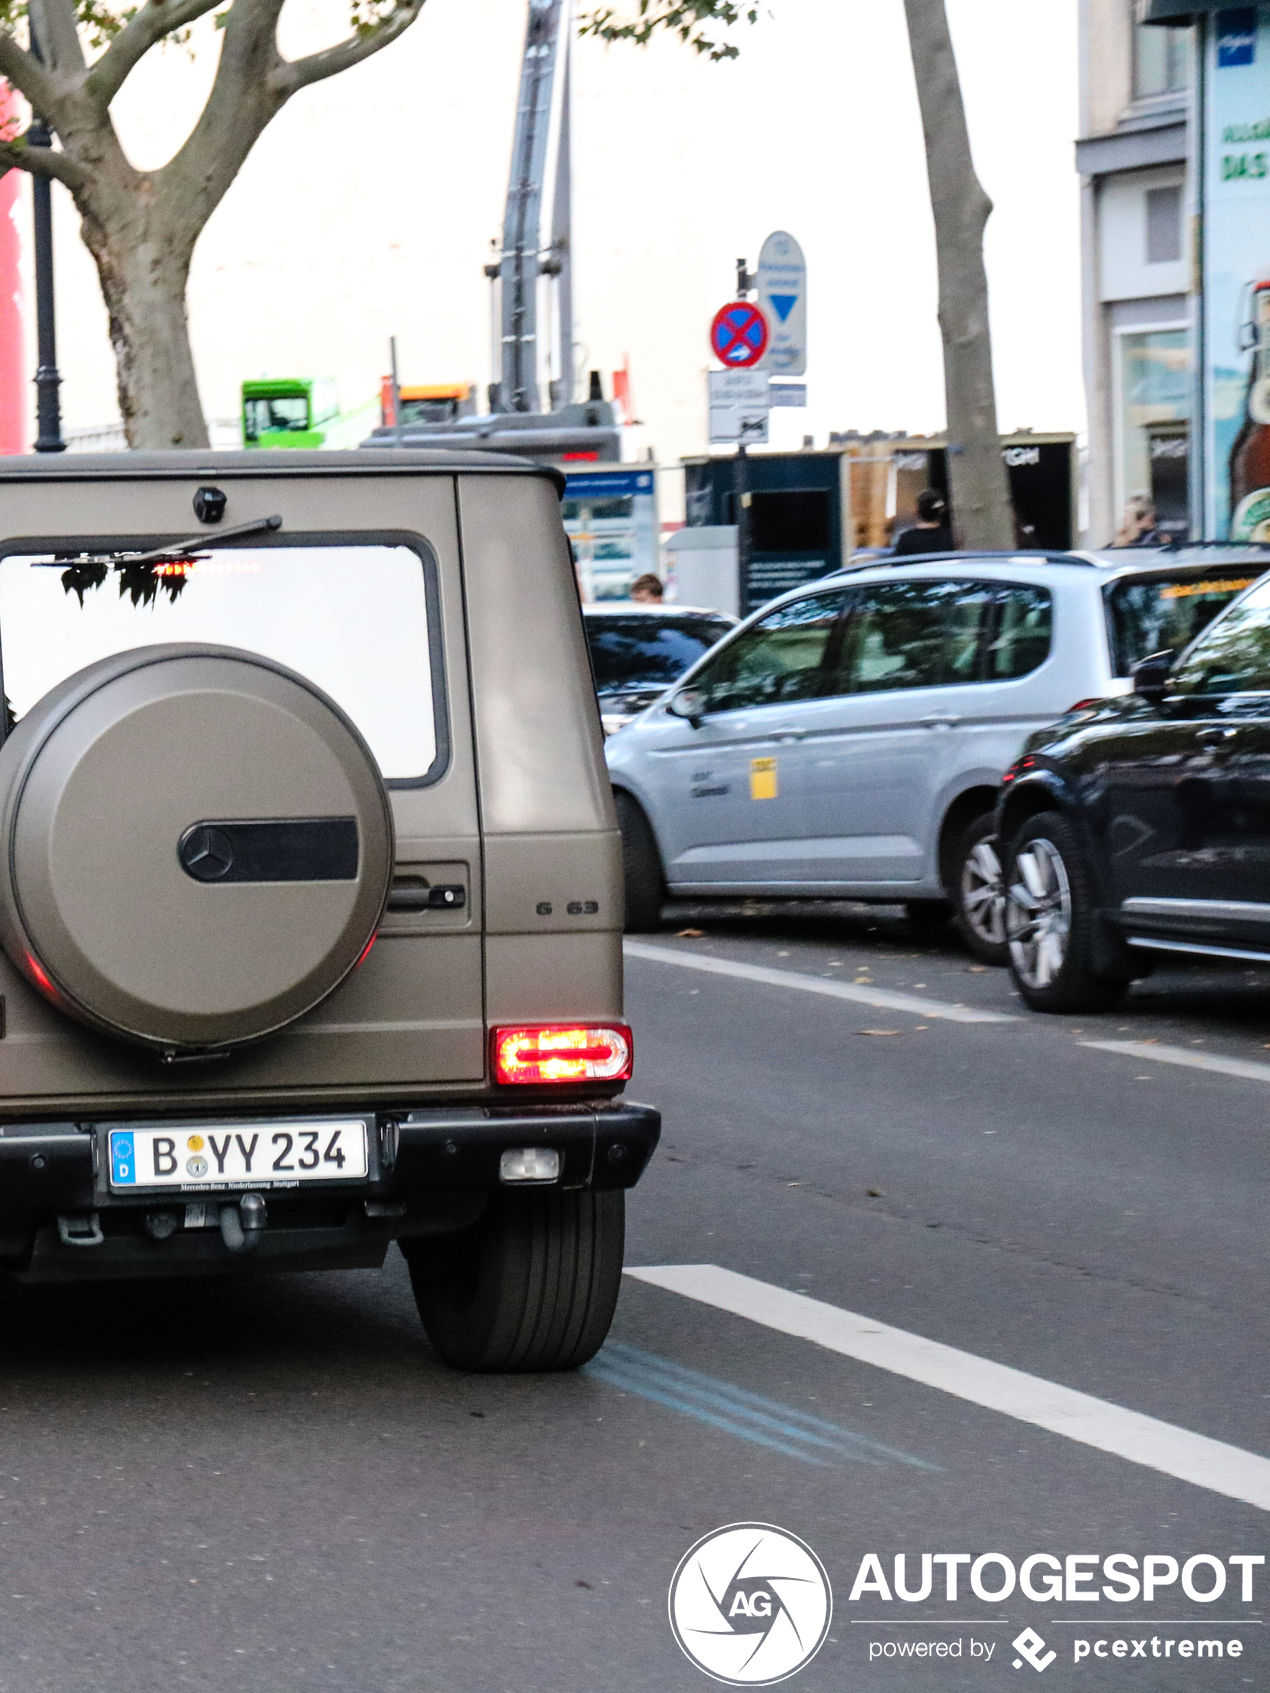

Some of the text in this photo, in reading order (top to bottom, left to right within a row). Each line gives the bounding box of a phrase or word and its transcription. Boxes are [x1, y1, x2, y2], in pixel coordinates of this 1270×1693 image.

[535, 900, 599, 915] G 63
[152, 1129, 347, 1177] B YY 234
[119, 1163, 130, 1178] D
[228, 1181, 271, 1190] Niederlassung
[272, 1180, 300, 1189] Stuttgart
